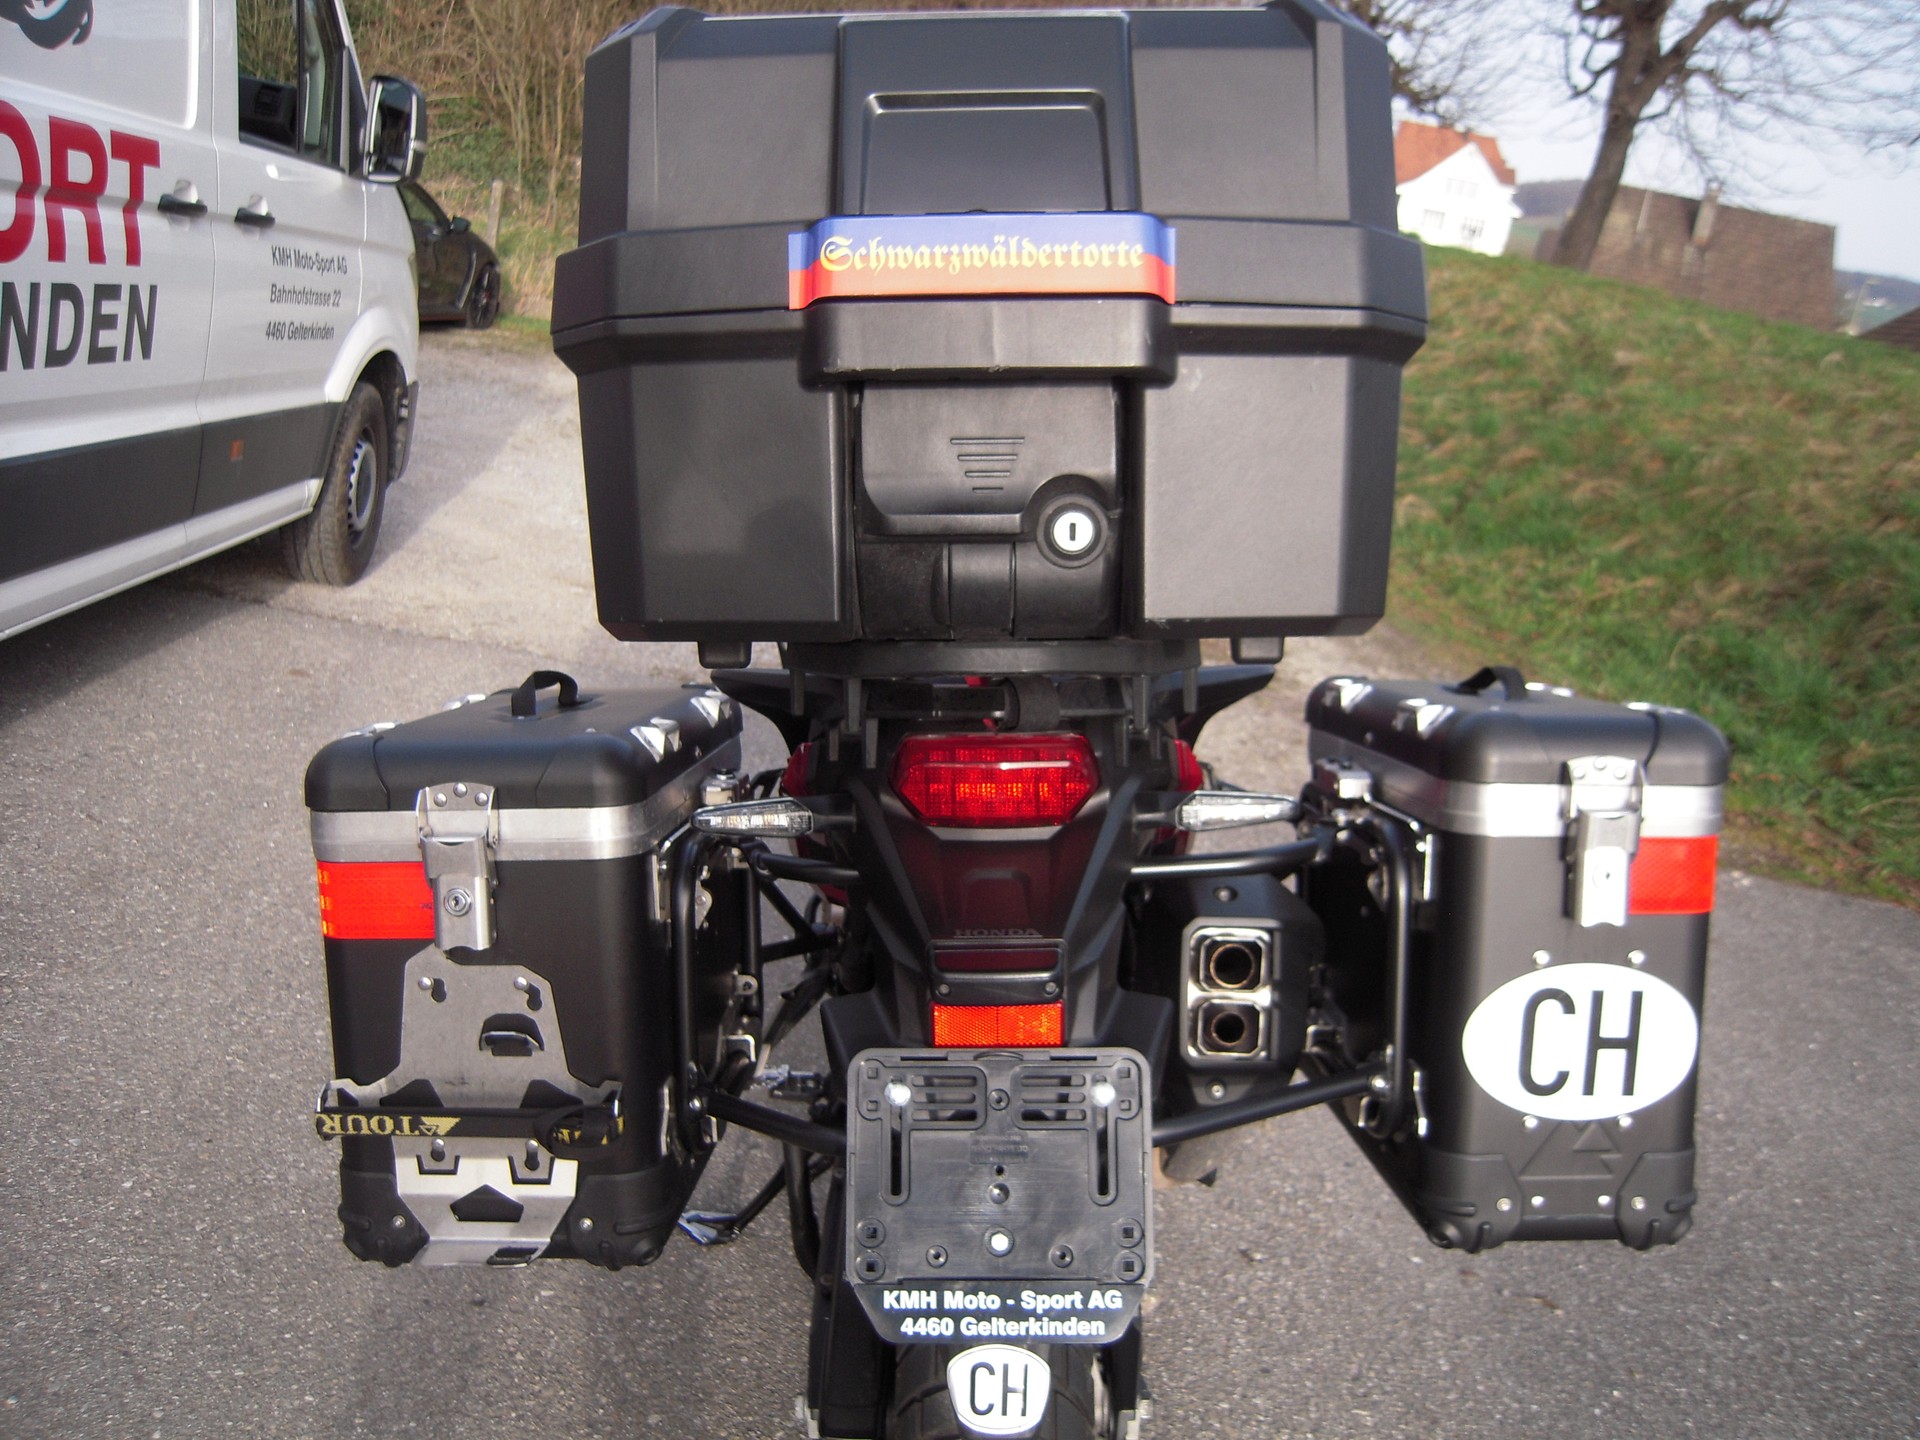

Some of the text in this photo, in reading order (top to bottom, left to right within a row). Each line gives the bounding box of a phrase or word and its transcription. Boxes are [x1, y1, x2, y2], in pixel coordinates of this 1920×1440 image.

[271, 245, 348, 276] KMH Moto-Sport AG
[820, 235, 1145, 276] Schwarzwäldertorte
[270, 283, 341, 307] Bahnhofstrasse 22
[0, 281, 158, 371] NDEN
[266, 321, 335, 340] 4460 Gelterkinden
[954, 928, 1041, 937] HONDA
[1518, 987, 1643, 1096] CH
[883, 1290, 937, 1310] KMH
[944, 1290, 1000, 1310] Moto
[1020, 1290, 1083, 1314] Sport
[1087, 1289, 1123, 1310] AG
[900, 1317, 1105, 1336] 4460 Gelterkinden
[969, 1361, 1028, 1417] CH
